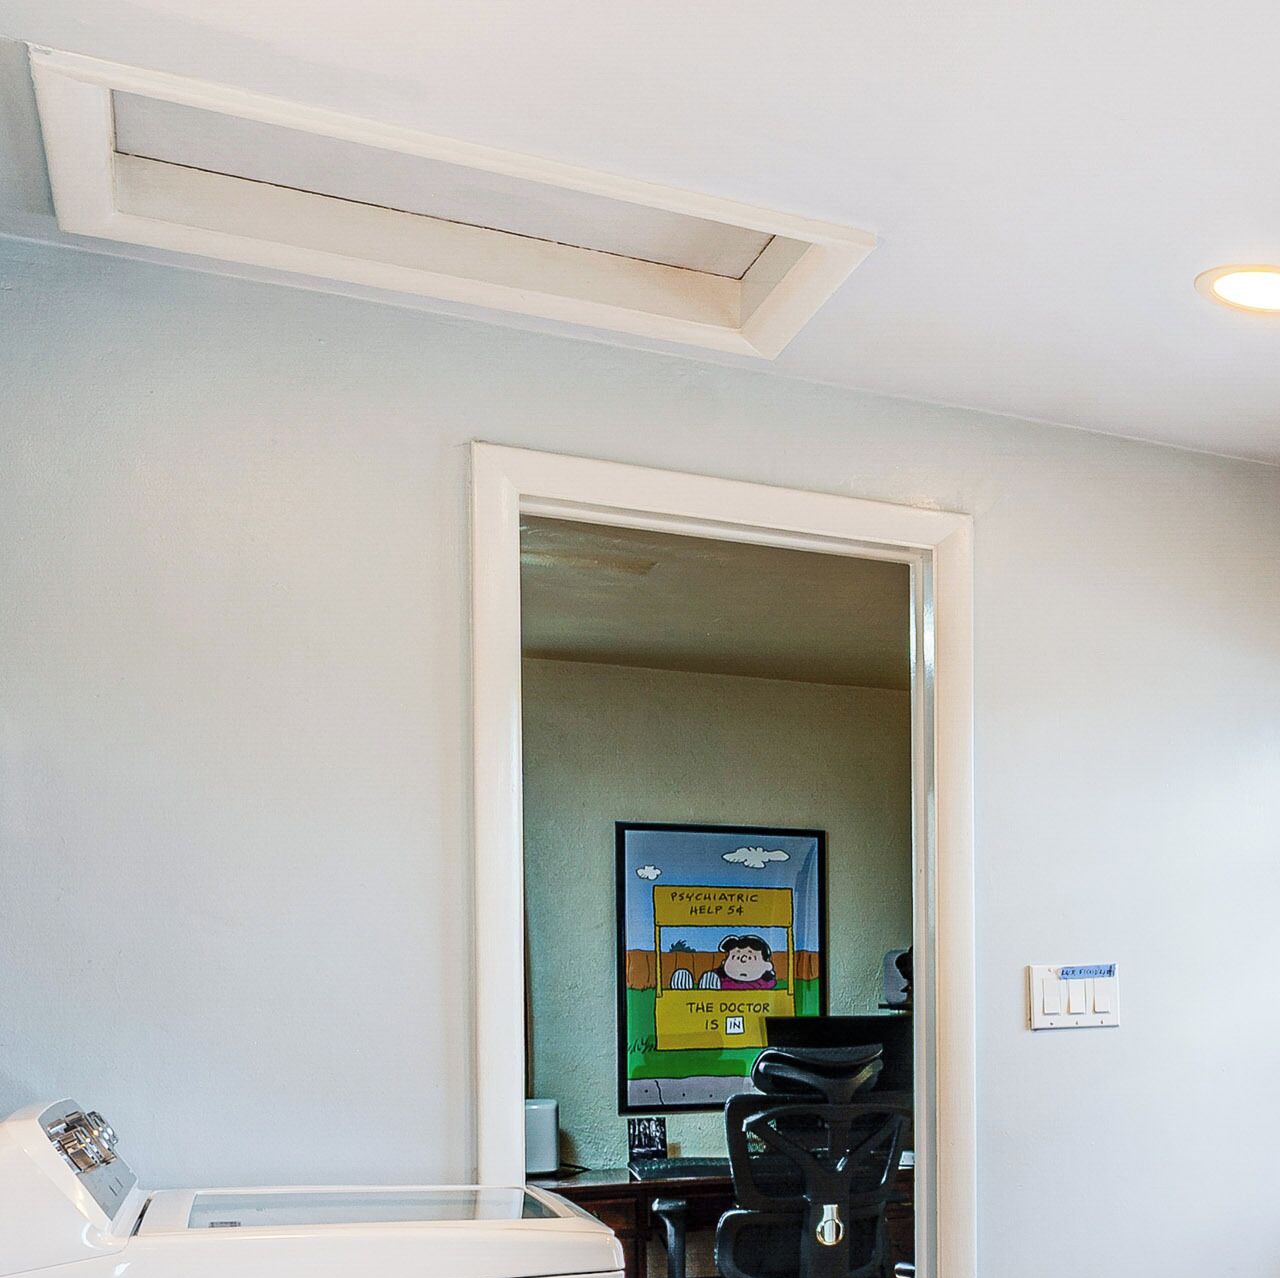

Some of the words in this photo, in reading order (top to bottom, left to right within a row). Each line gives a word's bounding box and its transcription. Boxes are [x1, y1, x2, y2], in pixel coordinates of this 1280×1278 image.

[670, 891, 759, 903] PSYCHIATRIC
[689, 904, 723, 916] HELP
[686, 1001, 714, 1013] THE
[719, 1001, 770, 1014] DOCTOR
[705, 1019, 719, 1031] IS
[729, 1020, 742, 1030] IN
